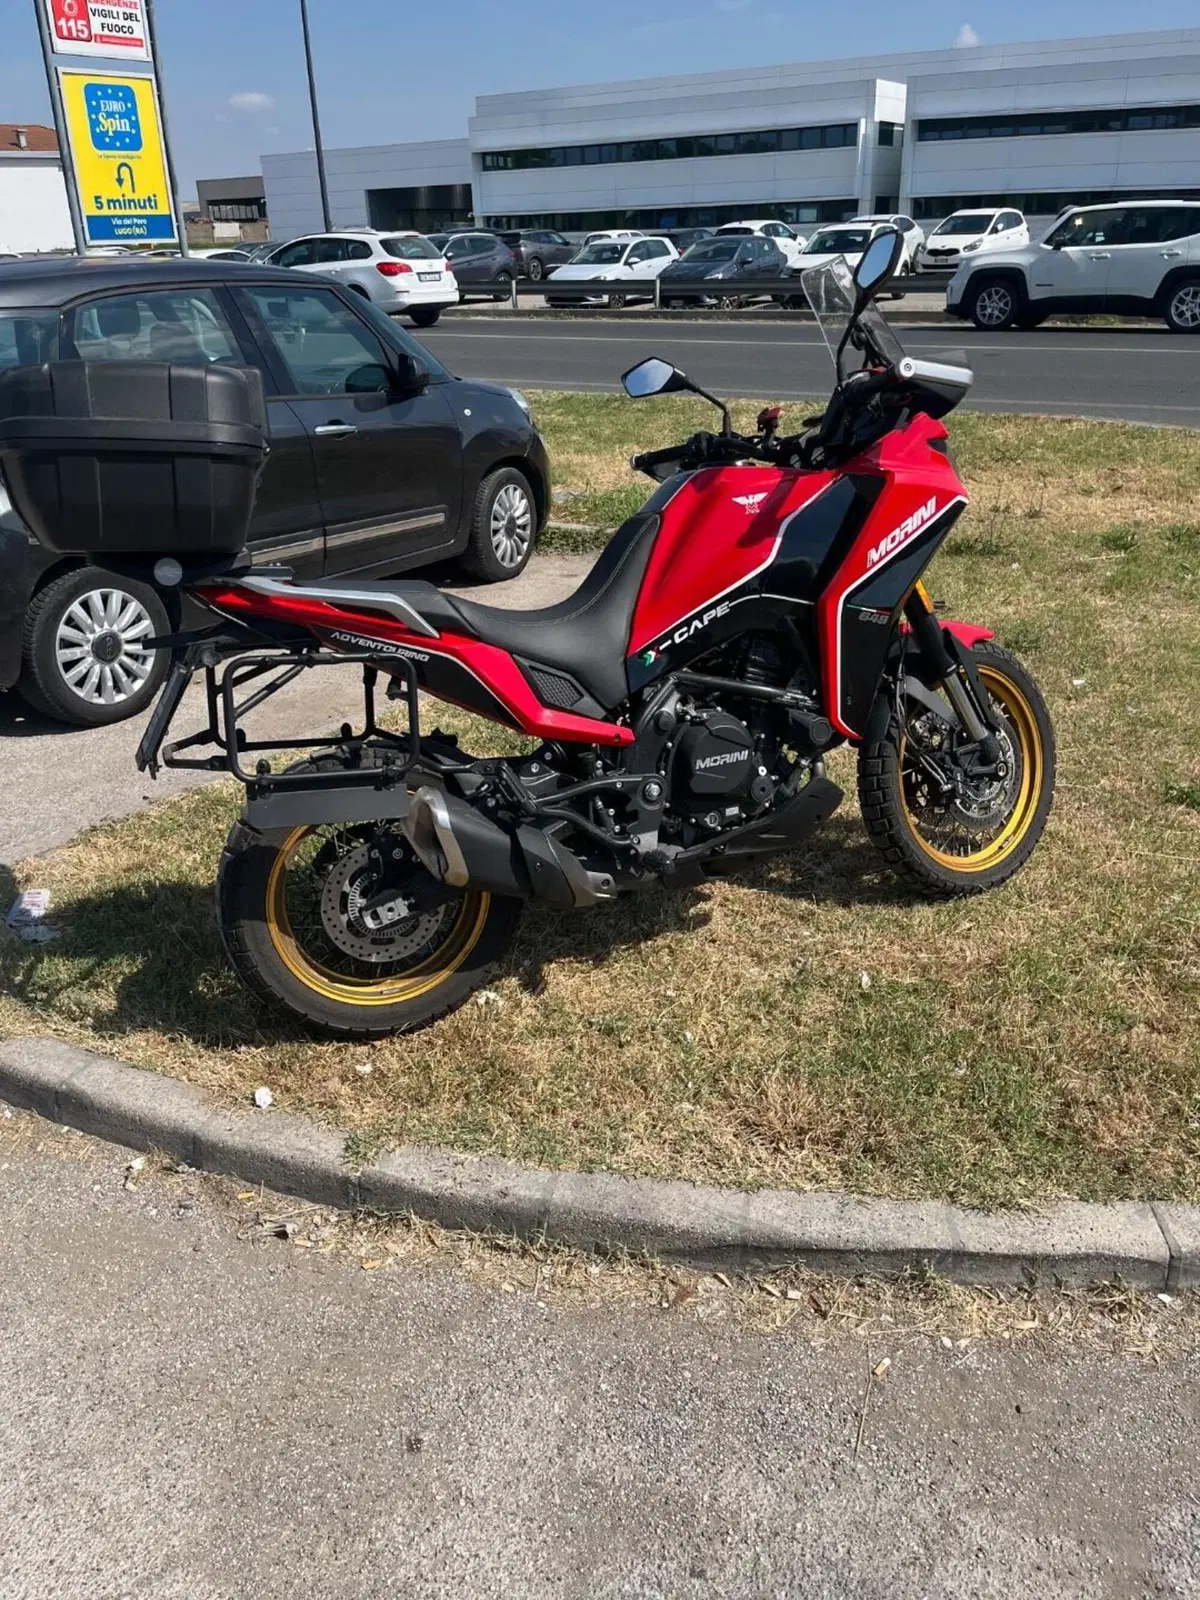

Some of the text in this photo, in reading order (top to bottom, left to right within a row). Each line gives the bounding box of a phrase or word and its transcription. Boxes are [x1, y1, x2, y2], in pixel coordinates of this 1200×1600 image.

[90, 7, 140, 22] VIGILI DEL
[57, 18, 89, 39] 115
[100, 22, 134, 35] FUOCO
[100, 100, 126, 112] EURO
[98, 112, 131, 136] Spin
[94, 193, 158, 210] 5 minuti
[111, 217, 122, 225] Via
[123, 217, 132, 225] del
[867, 495, 937, 569] MORINI
[331, 631, 430, 662] ADVENTOURING
[695, 749, 749, 770] MORINI
